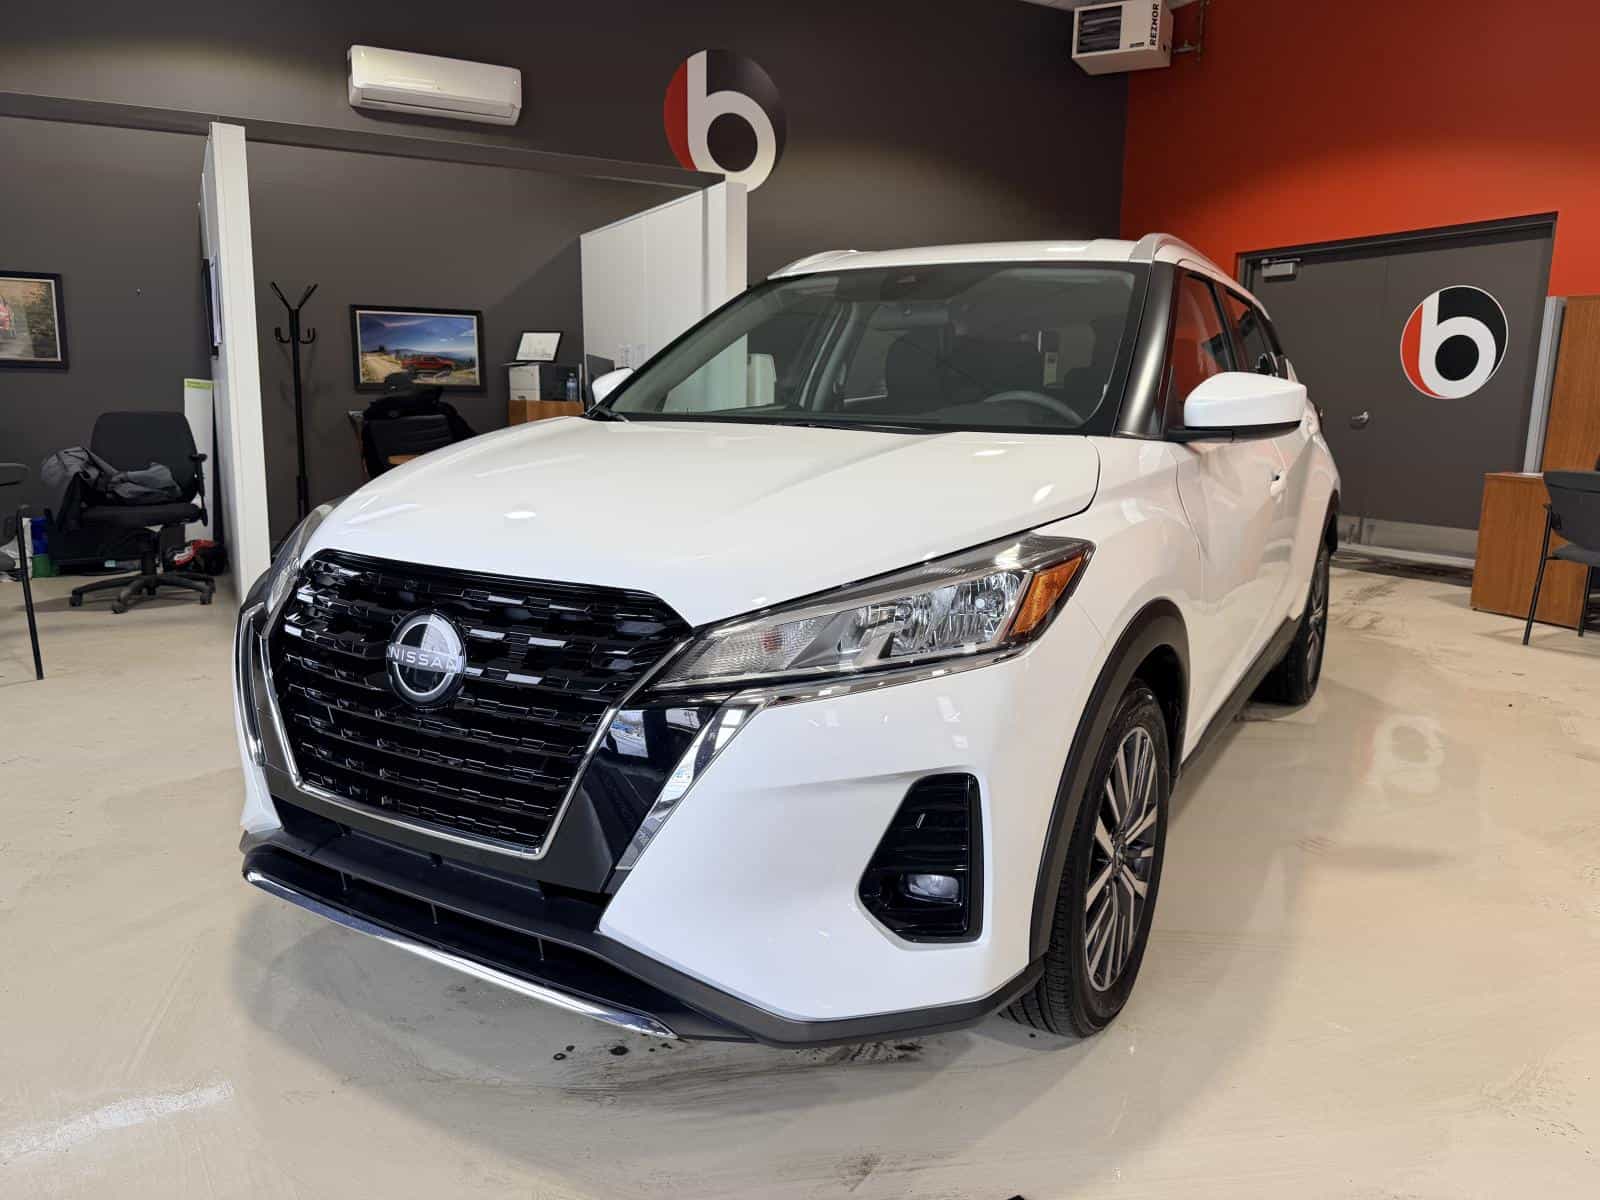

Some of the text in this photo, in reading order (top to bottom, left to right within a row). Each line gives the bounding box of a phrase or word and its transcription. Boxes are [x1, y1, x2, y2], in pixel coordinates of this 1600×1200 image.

[1150, 3, 1160, 46] REZNOR
[687, 50, 776, 192] b
[1418, 288, 1498, 399] b
[389, 646, 458, 671] NISSAN
